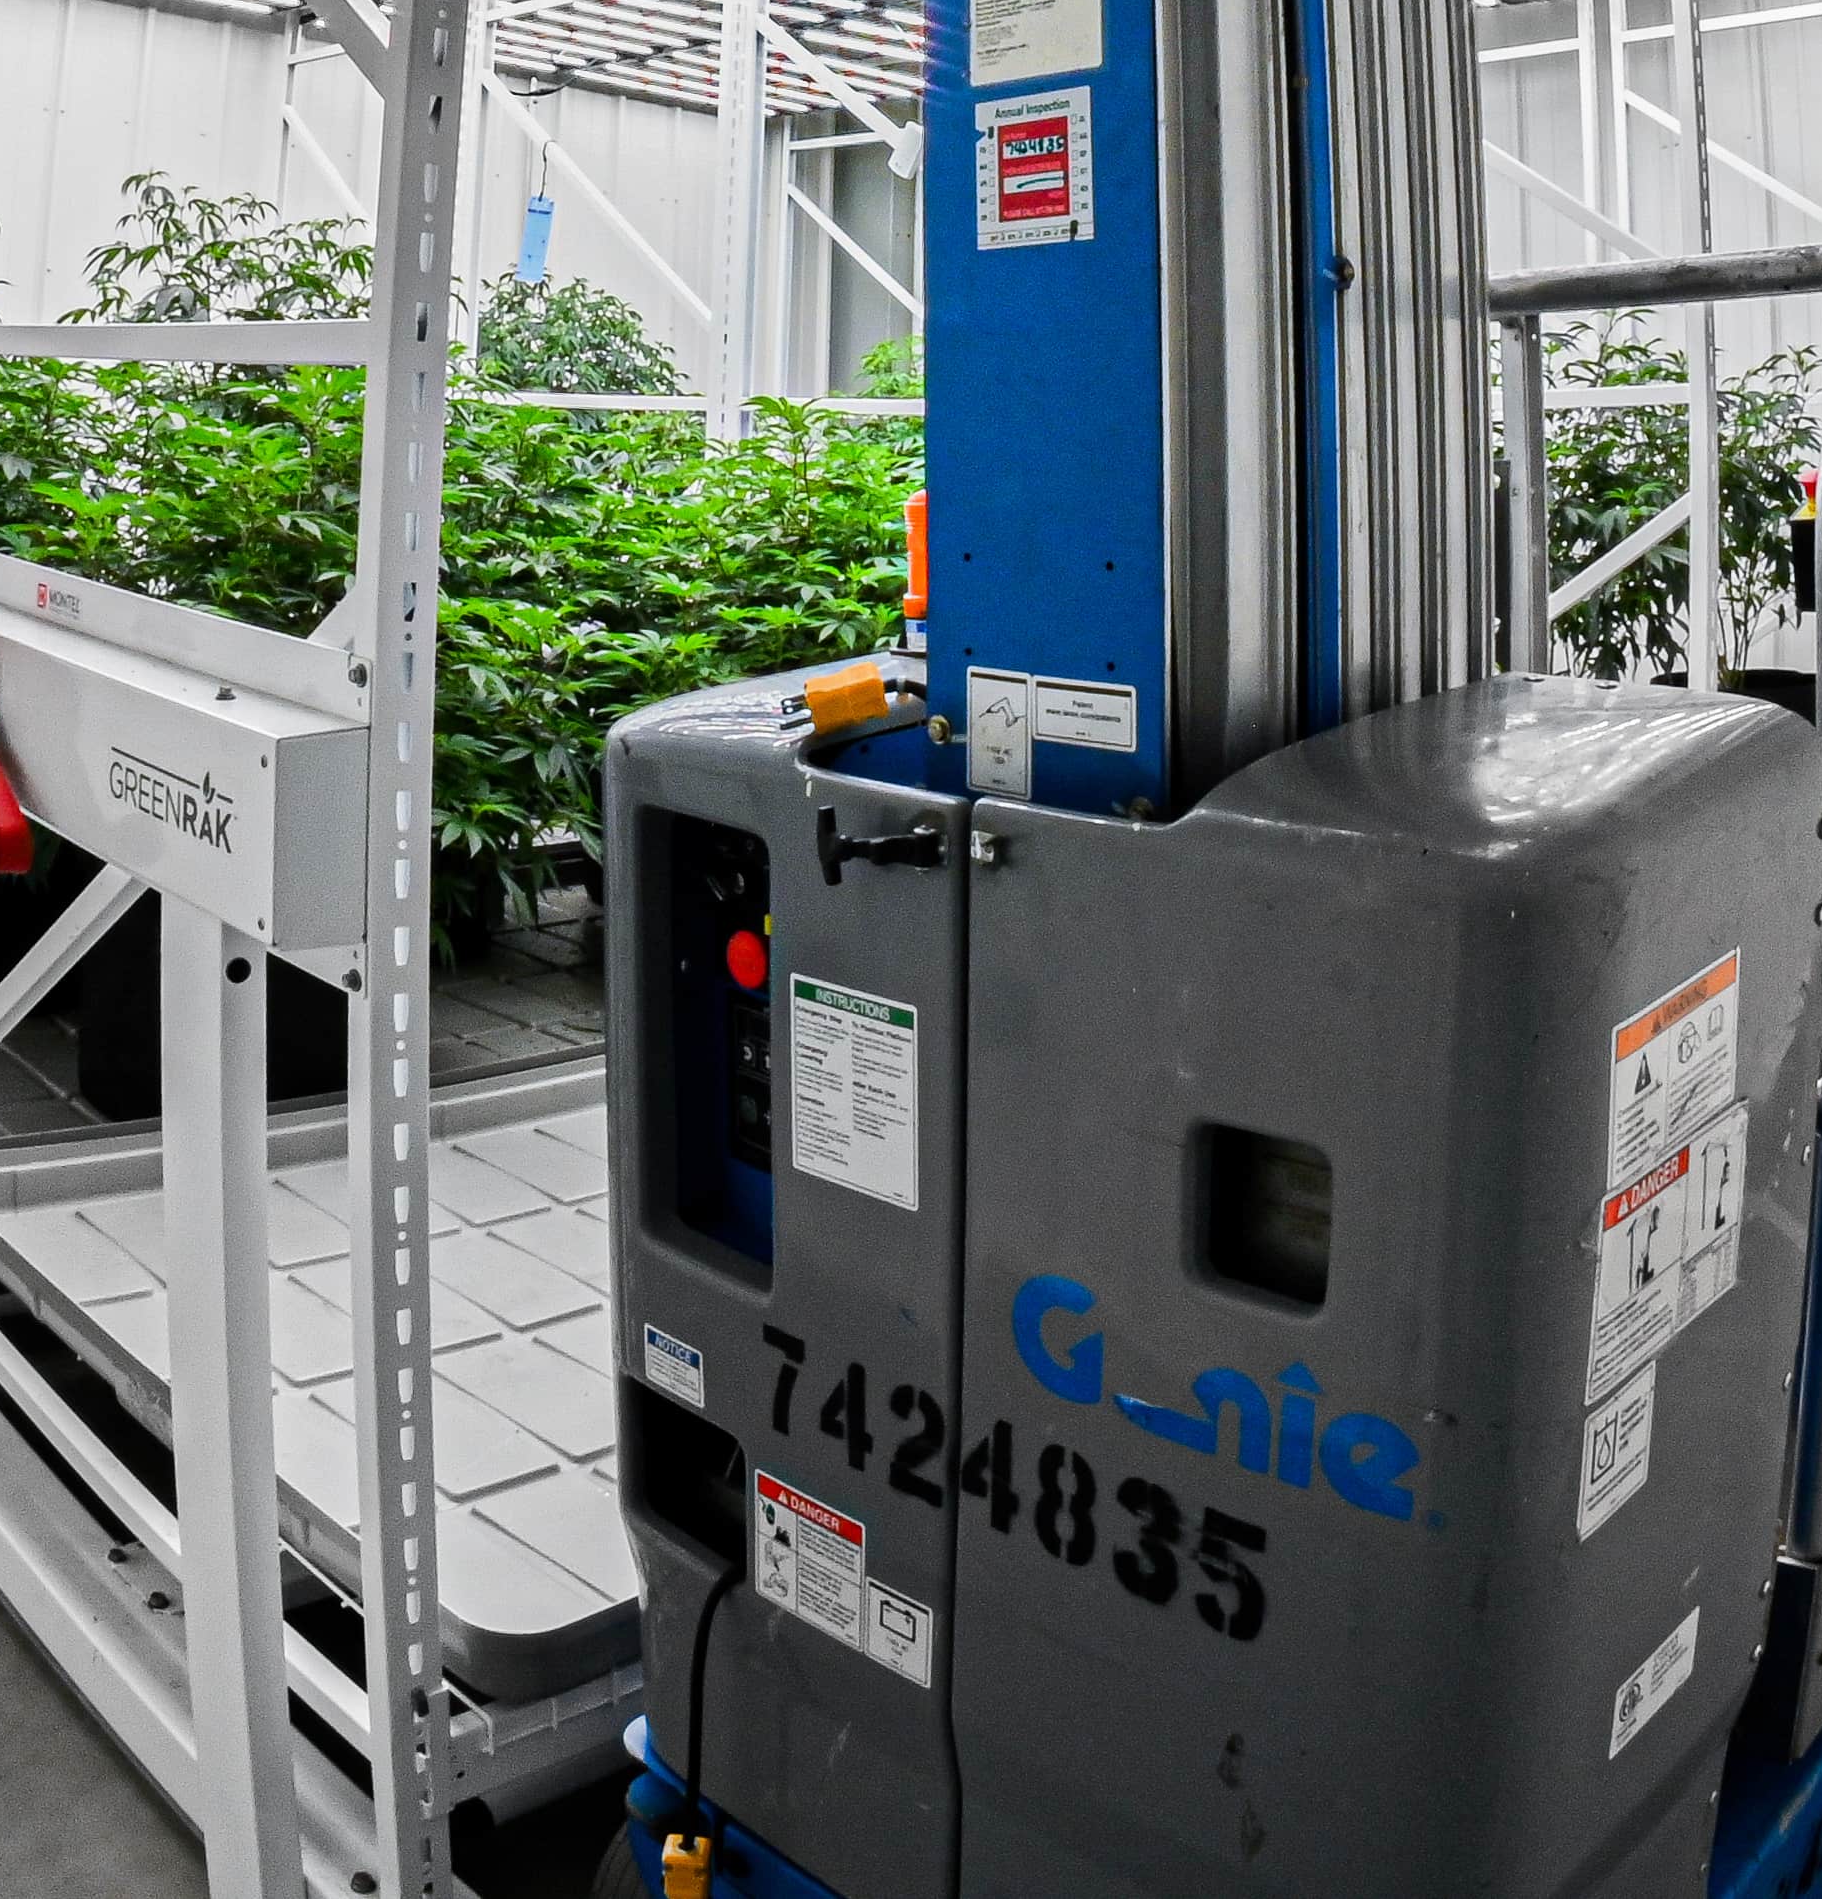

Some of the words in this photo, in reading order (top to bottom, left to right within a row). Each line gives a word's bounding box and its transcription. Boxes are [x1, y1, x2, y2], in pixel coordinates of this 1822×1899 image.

[995, 104, 1024, 118] Annual
[1027, 99, 1071, 114] Inspection
[109, 761, 233, 854] GREENRAK
[814, 987, 891, 1022] INSTRUCTIONS
[1631, 1156, 1679, 1210] DANGER
[654, 1333, 692, 1363] NOTICE
[762, 1323, 1269, 1644] 7424835
[790, 1496, 841, 1532] DANGER
